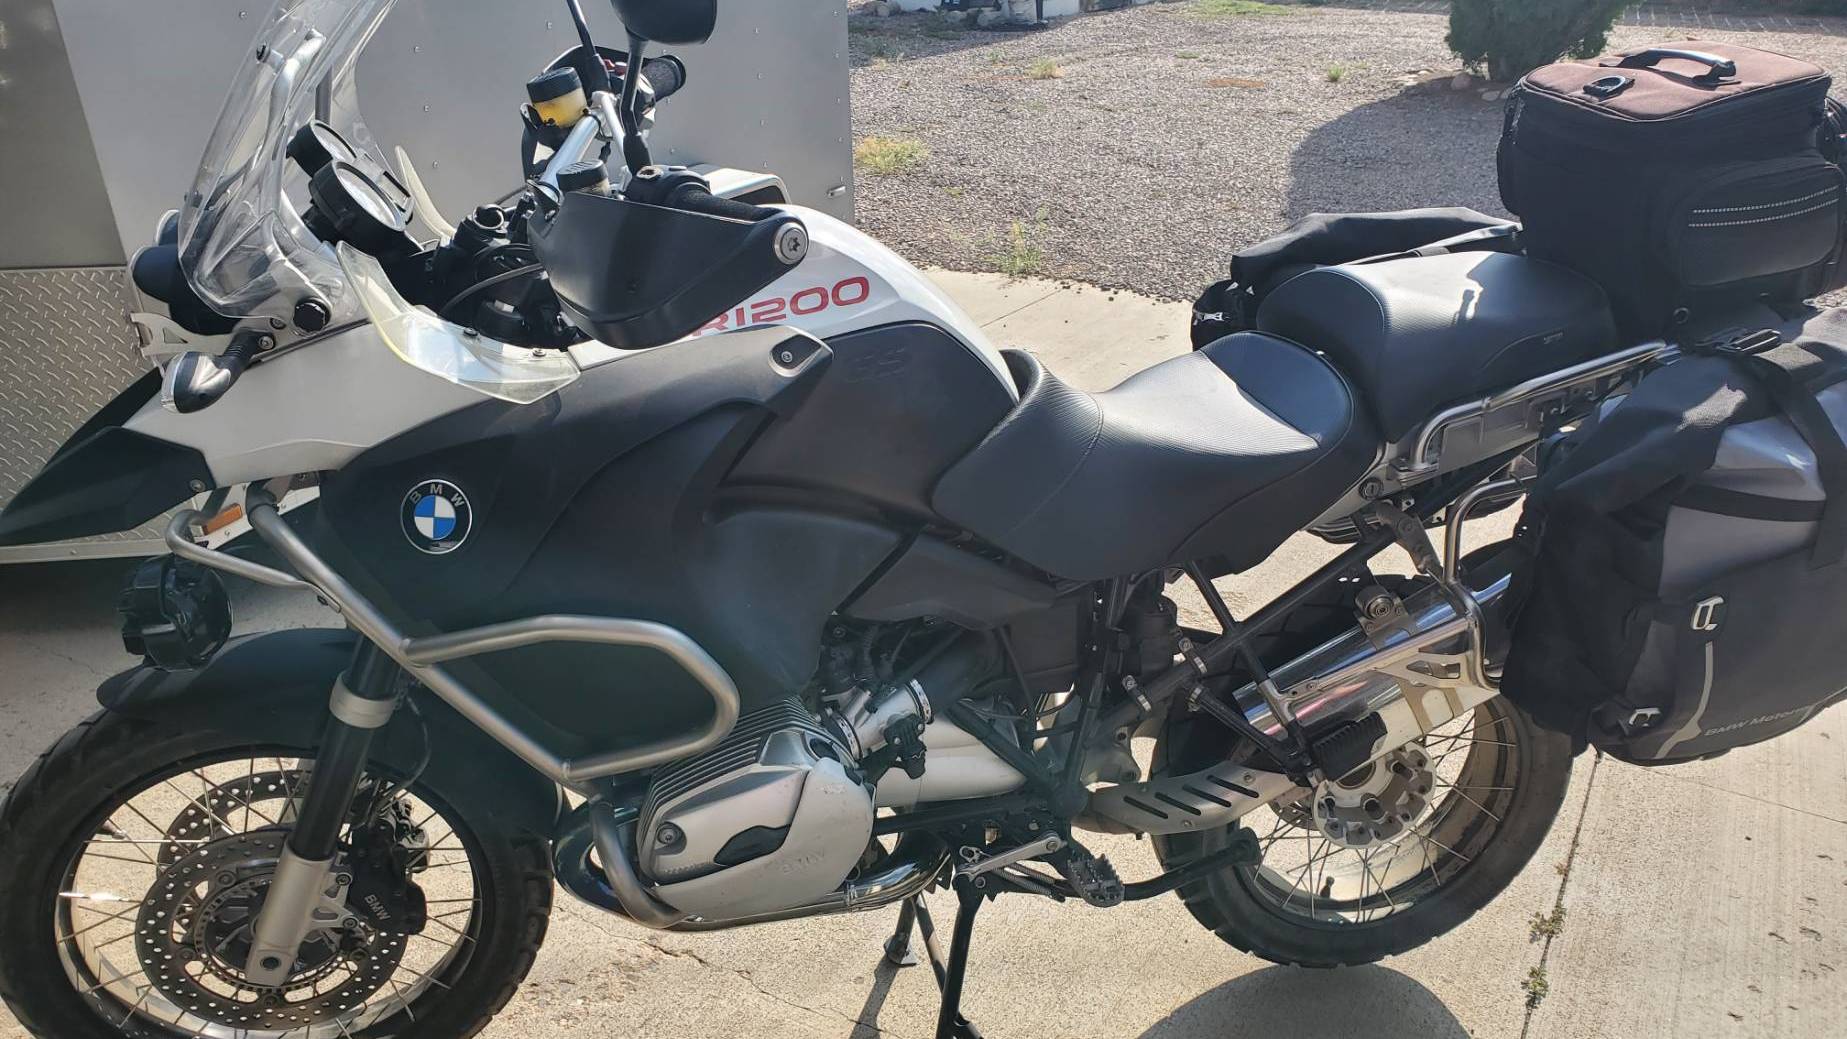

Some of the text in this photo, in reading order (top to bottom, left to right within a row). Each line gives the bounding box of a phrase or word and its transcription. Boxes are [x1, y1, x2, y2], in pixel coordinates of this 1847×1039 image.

[409, 483, 465, 508] BMW
[1704, 719, 1751, 736] BMW
[364, 894, 391, 920] BMW
